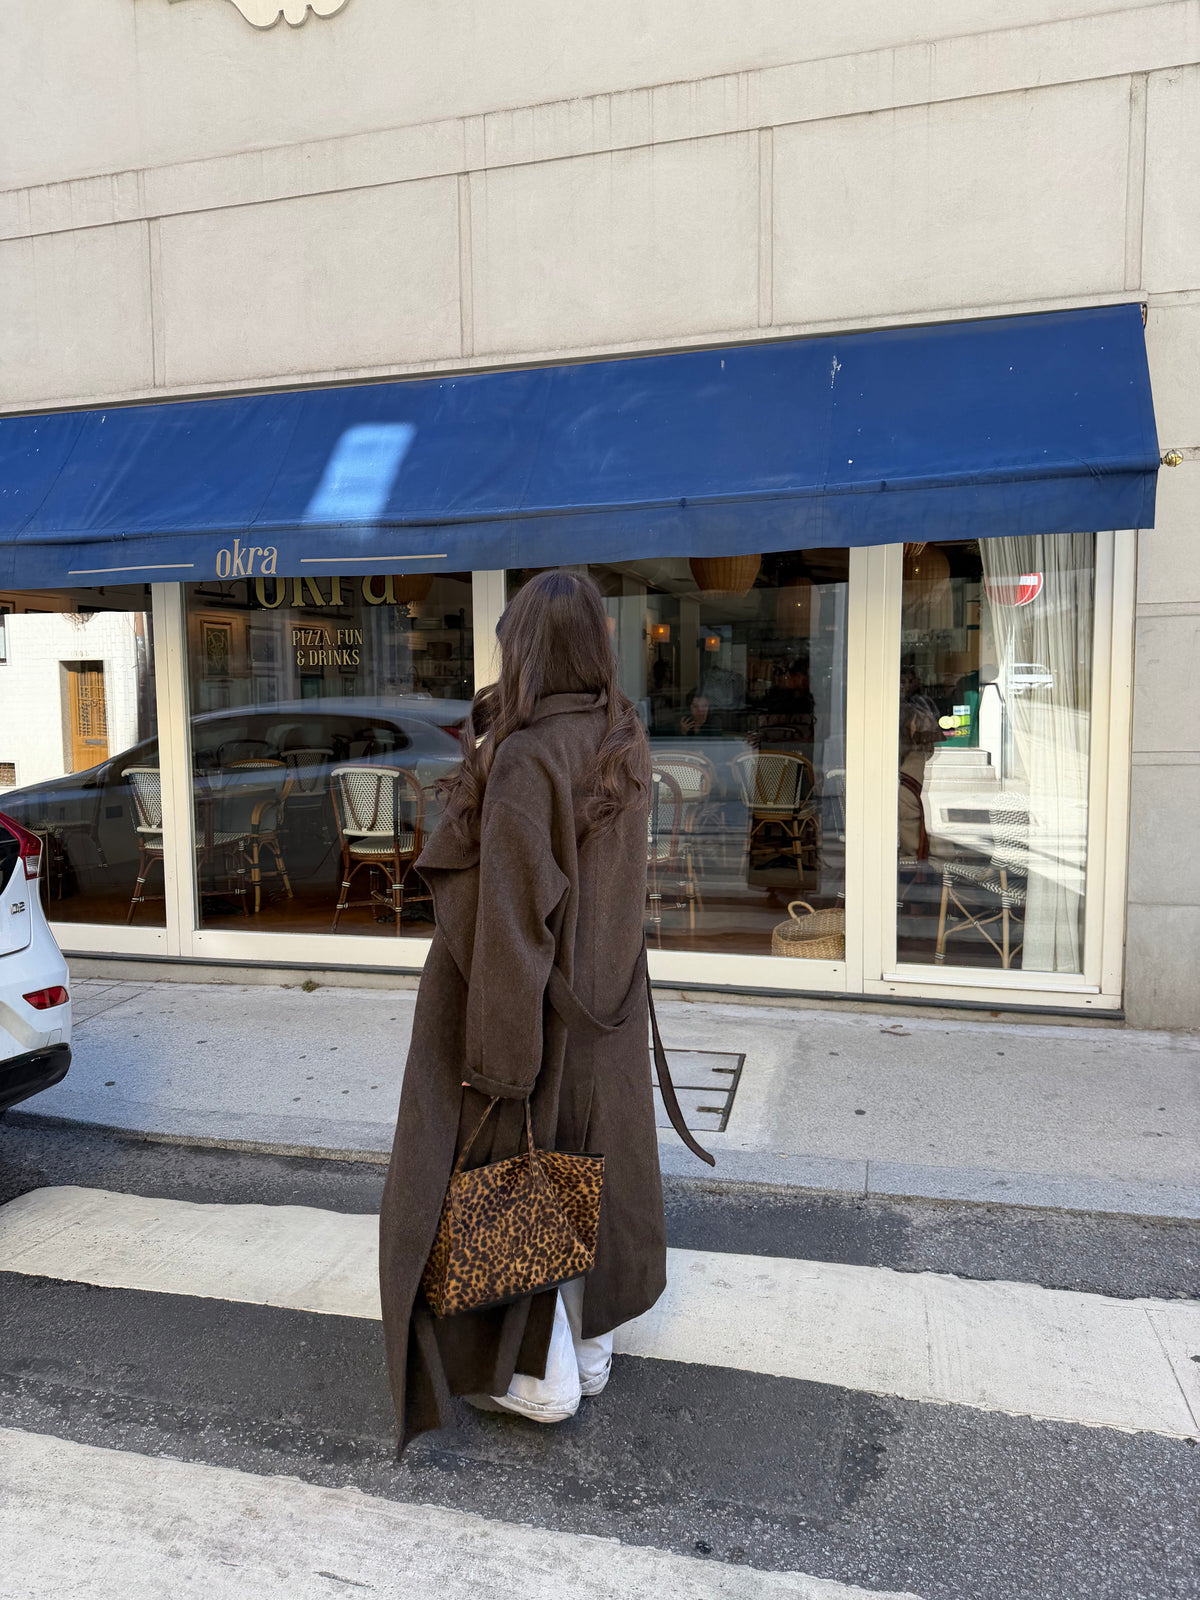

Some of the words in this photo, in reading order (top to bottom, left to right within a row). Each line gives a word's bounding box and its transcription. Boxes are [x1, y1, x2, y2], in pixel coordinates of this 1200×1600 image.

[215, 539, 278, 578] okra
[292, 629, 335, 648] PIZZA,
[337, 629, 364, 646] FUN
[296, 650, 305, 666] &
[309, 649, 360, 666] DRINKS
